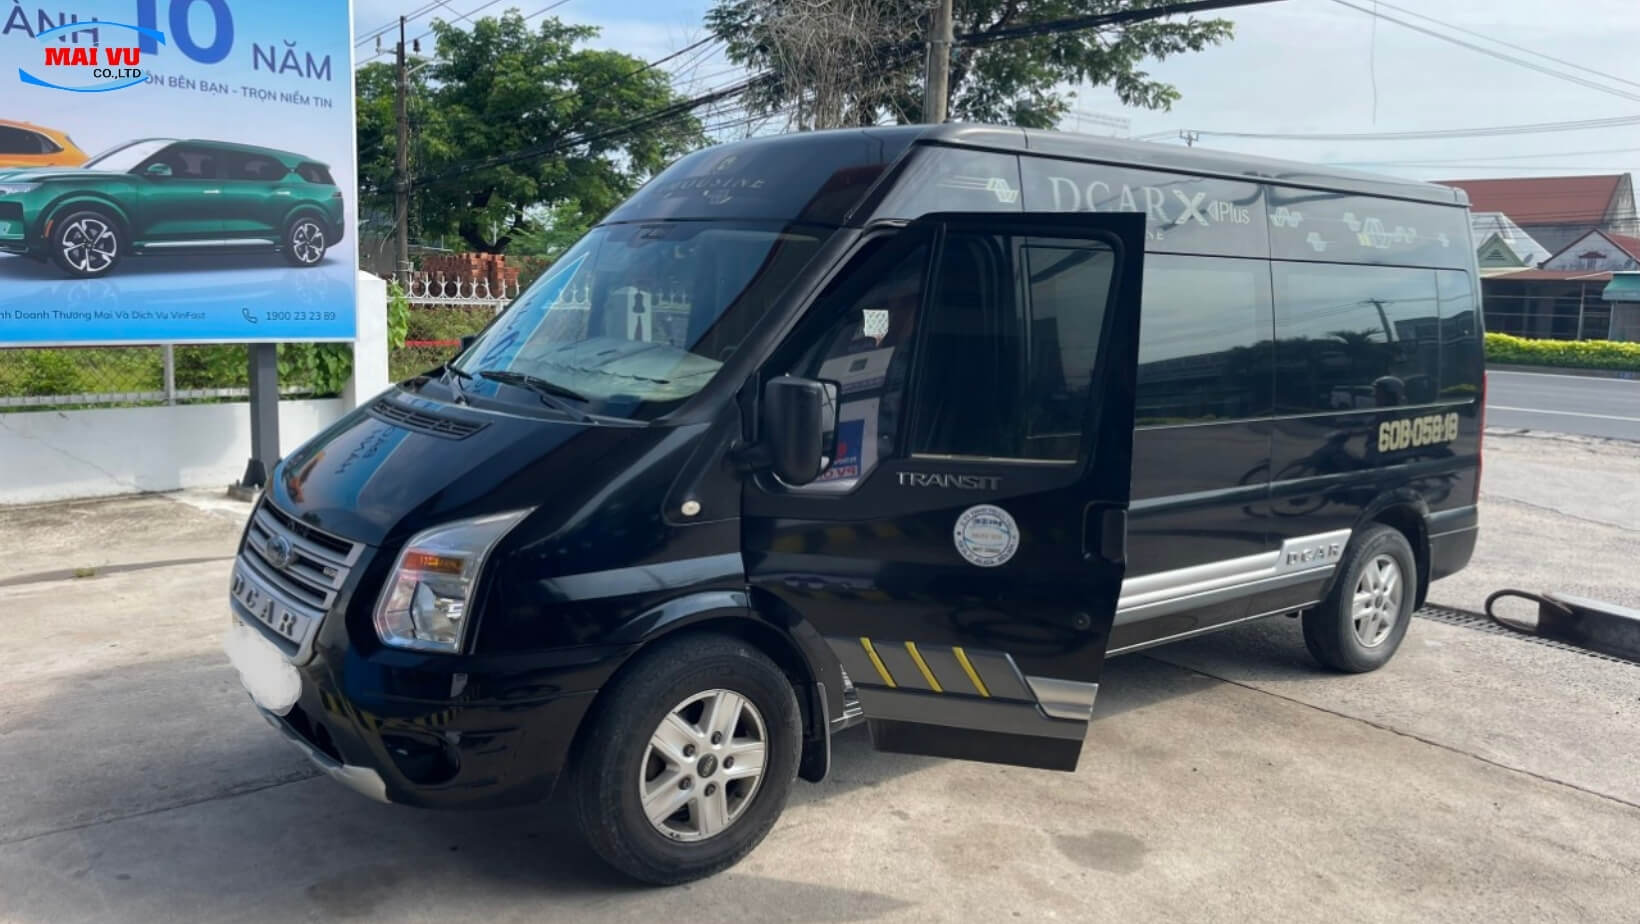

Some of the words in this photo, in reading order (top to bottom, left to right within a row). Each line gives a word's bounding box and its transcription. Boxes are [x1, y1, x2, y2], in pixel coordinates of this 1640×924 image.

[137, 0, 234, 64] 10
[252, 40, 332, 81] NĂM
[168, 74, 196, 90] BÊN
[200, 80, 229, 96] BẠN
[241, 86, 277, 102] TRỌN
[312, 96, 332, 108] TIN
[14, 309, 50, 320] Doanh
[265, 311, 292, 321] 1900
[896, 471, 1003, 490] TRANSIT
[1286, 543, 1340, 566] DCAR
[232, 574, 299, 637] DCAR
